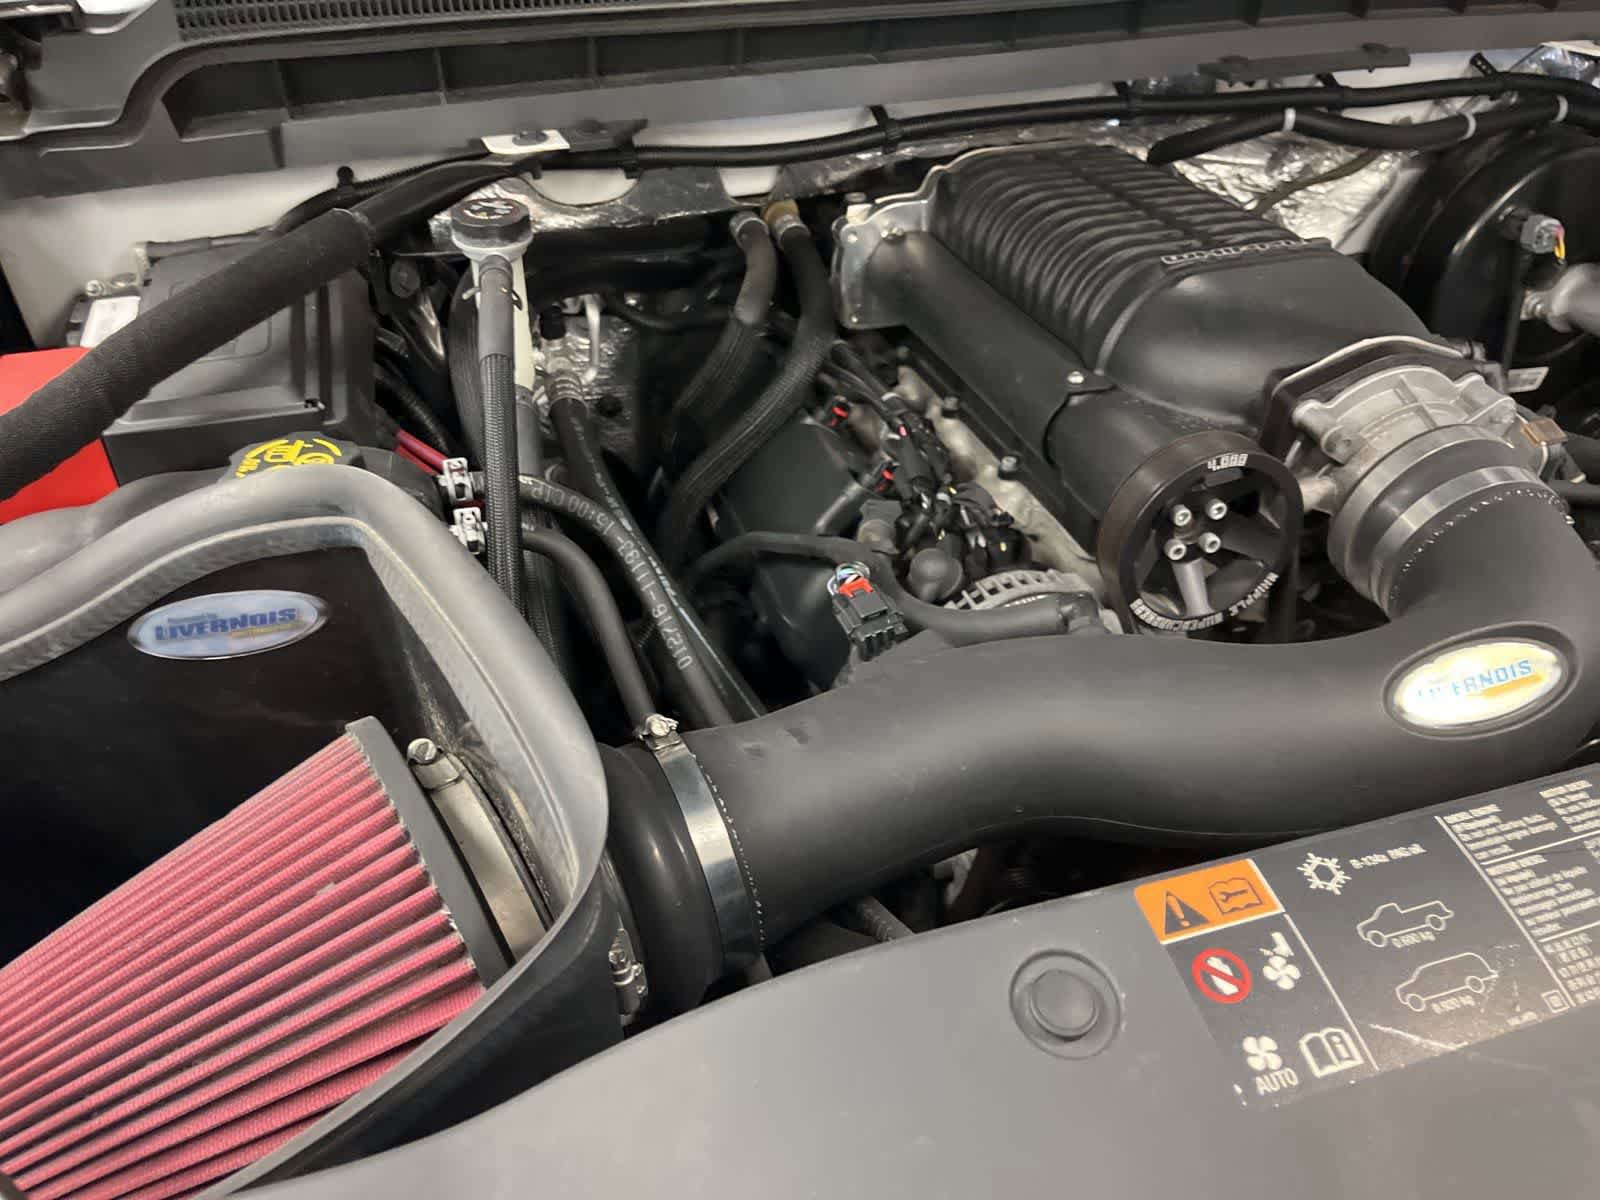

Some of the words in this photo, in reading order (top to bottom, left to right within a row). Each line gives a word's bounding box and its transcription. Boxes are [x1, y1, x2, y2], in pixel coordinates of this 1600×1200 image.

[1207, 453, 1249, 471] 4.000
[154, 607, 298, 642] LIVERNOIS
[1255, 1067, 1299, 1096] AUTO
